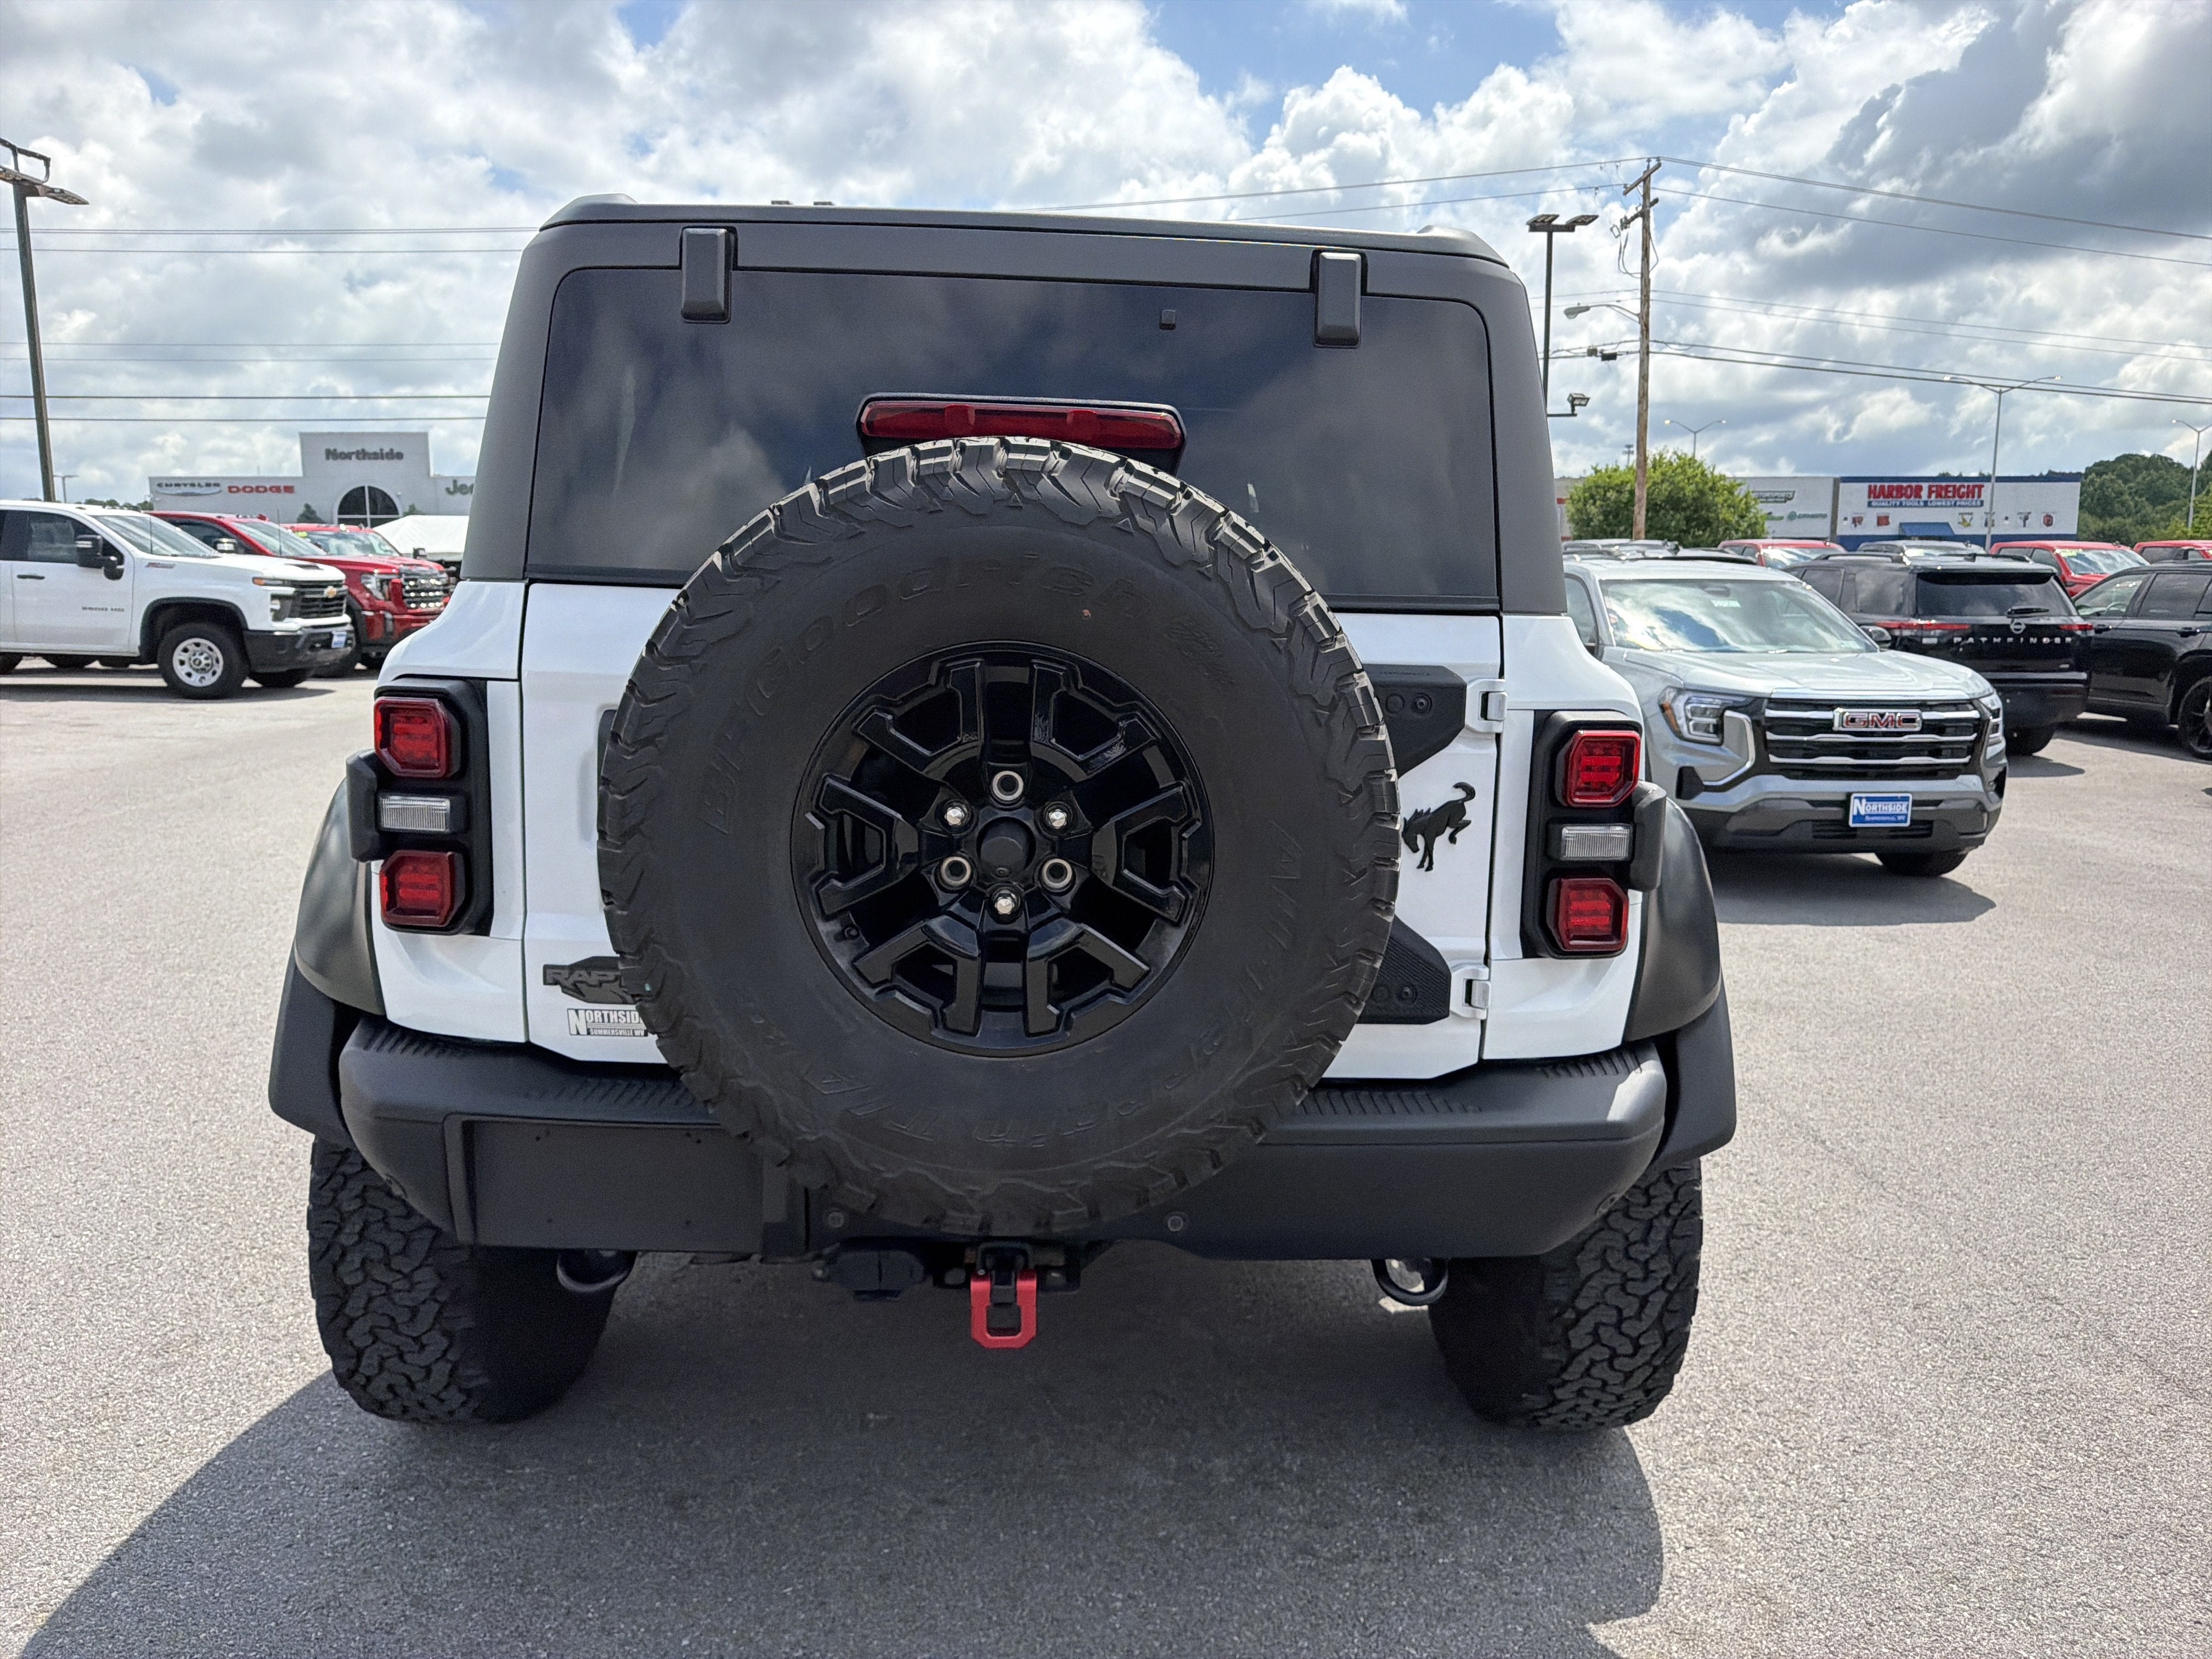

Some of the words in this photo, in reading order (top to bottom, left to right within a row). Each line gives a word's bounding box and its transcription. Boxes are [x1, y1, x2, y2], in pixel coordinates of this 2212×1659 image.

[325, 448, 404, 460] Northside
[228, 485, 295, 494] DODGE
[1868, 484, 1923, 499] HARBOR
[1927, 484, 1984, 499] FREIGHT
[1842, 712, 1921, 729] GMC
